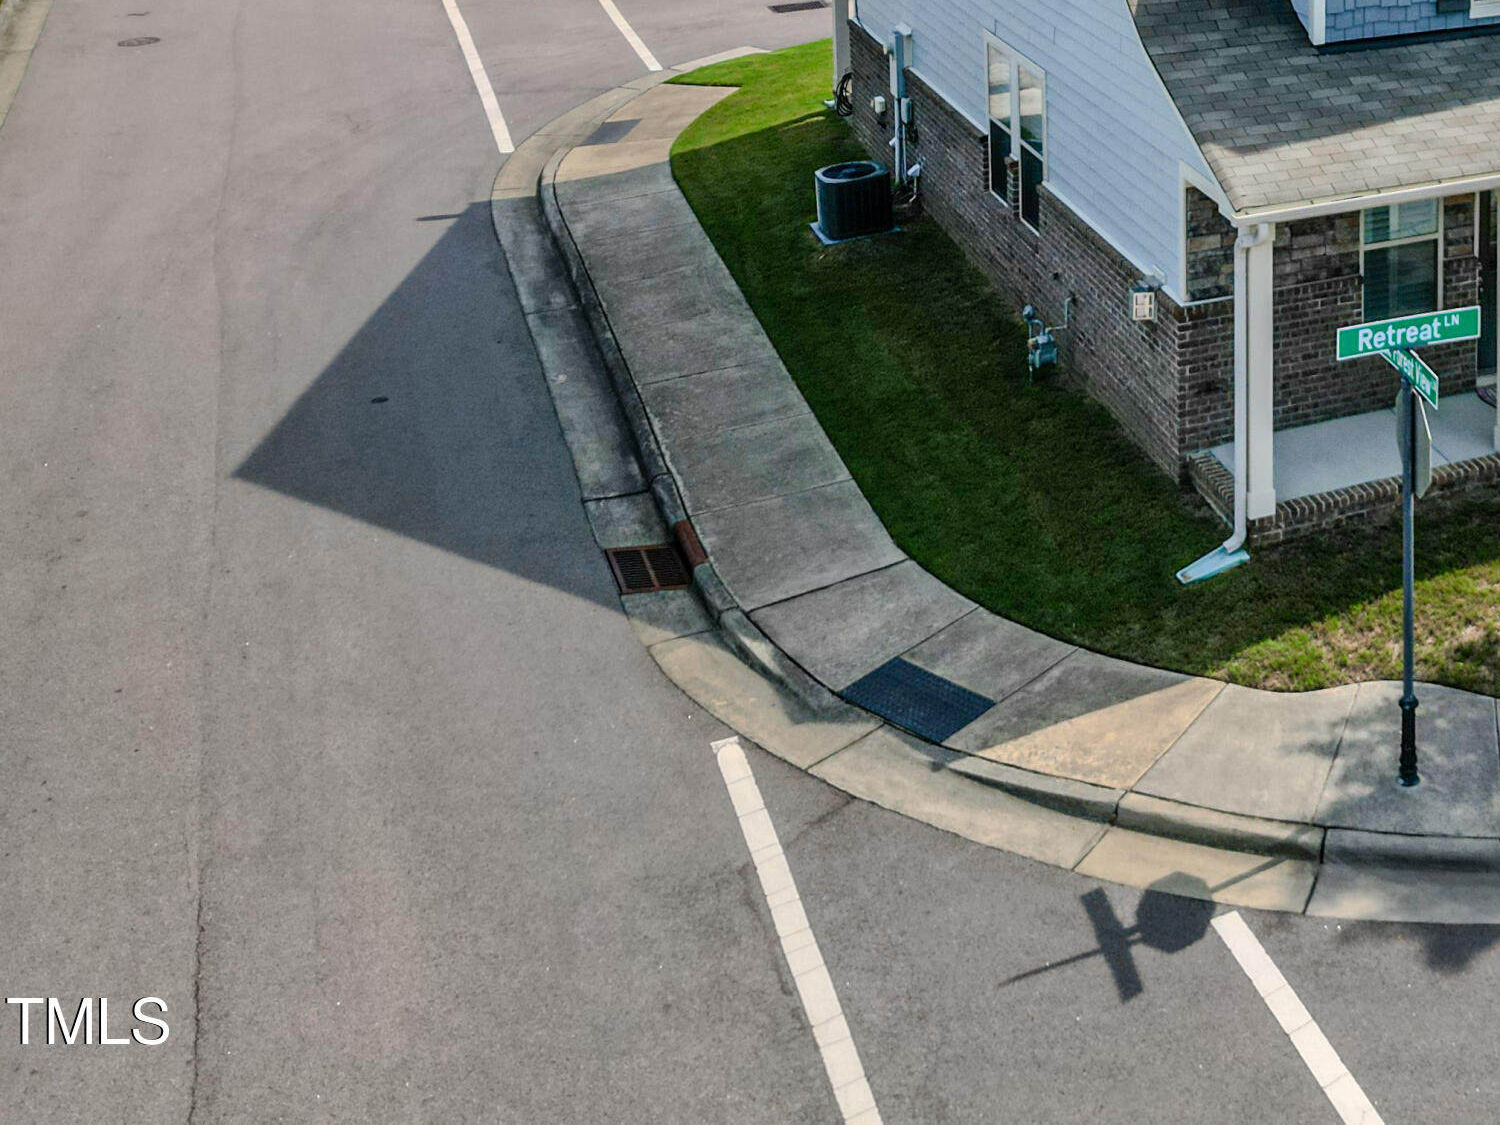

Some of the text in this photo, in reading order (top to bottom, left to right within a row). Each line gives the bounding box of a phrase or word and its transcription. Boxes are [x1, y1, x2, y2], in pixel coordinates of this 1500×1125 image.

[1358, 314, 1460, 352] Retreat LN
[1415, 360, 1431, 396] View
